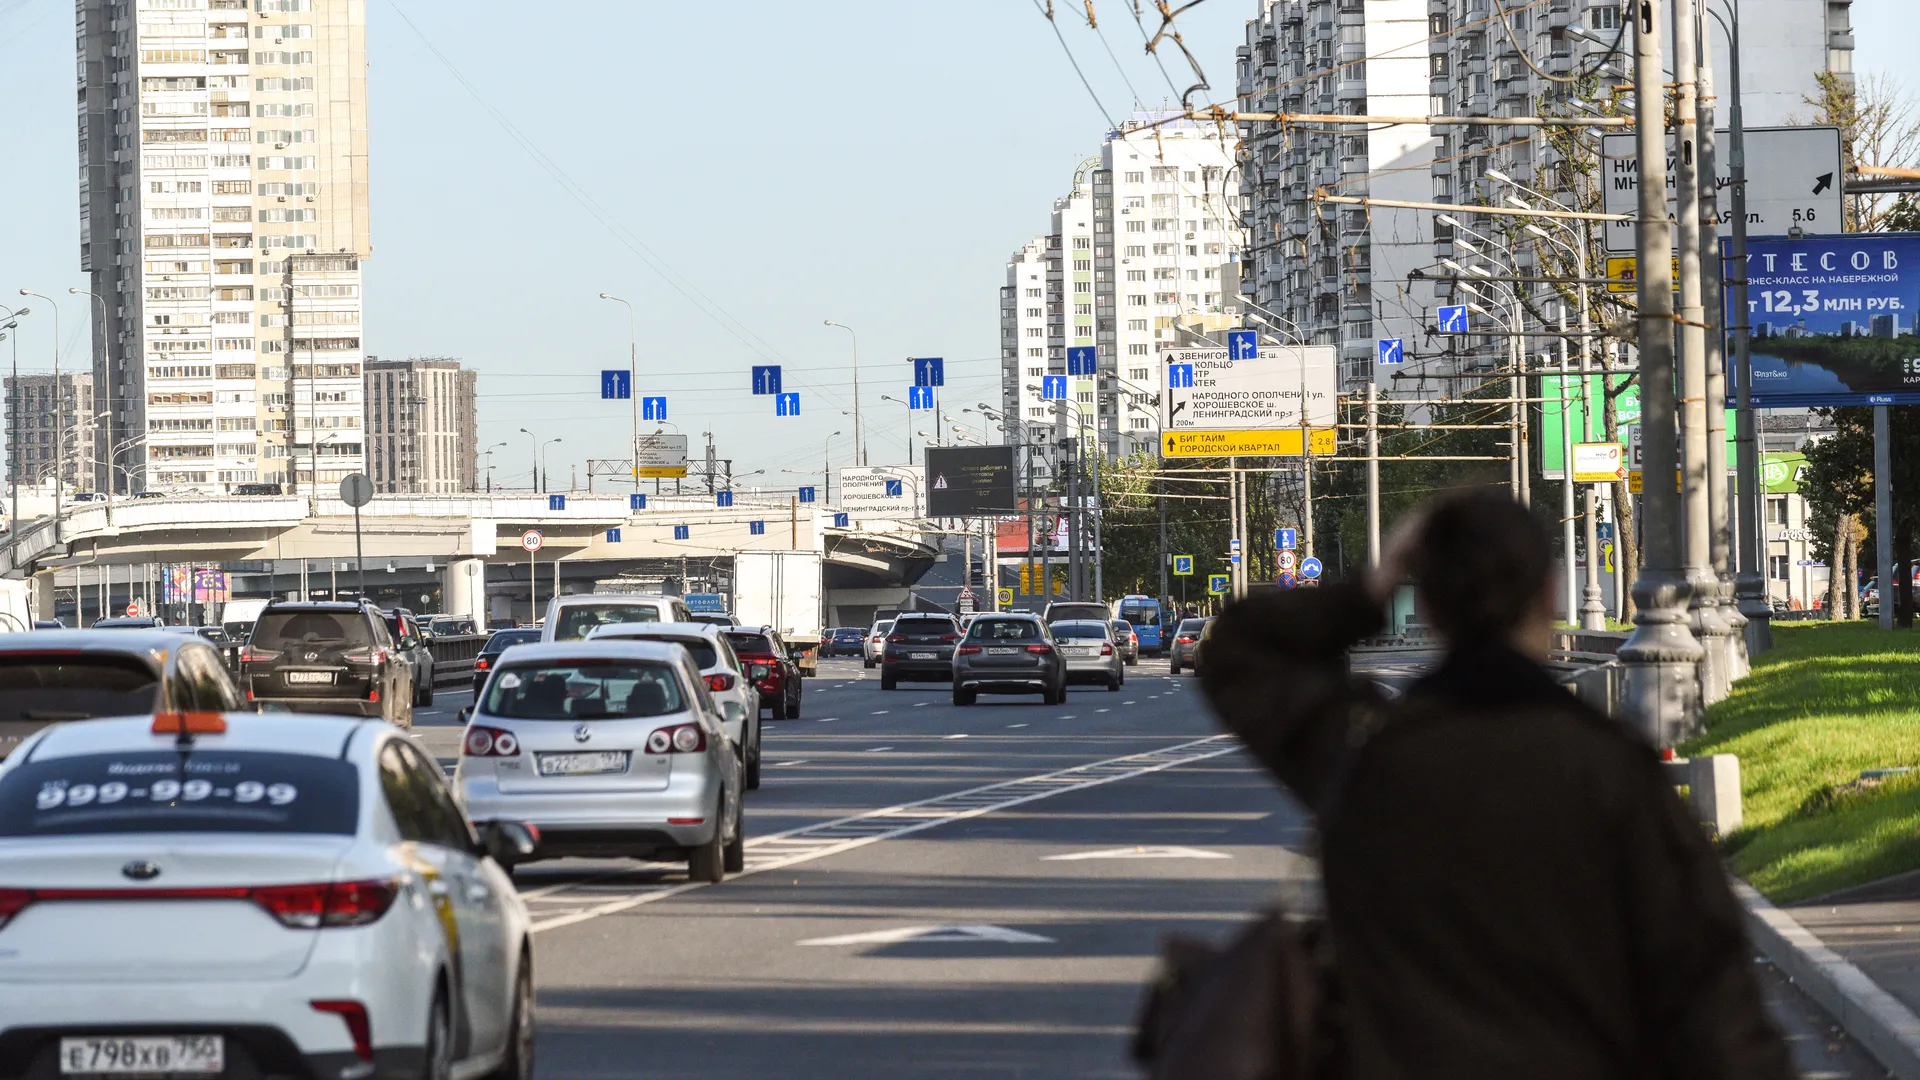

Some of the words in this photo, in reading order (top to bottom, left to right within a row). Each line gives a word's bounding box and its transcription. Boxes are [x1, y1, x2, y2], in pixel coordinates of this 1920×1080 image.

[1792, 208, 1816, 222] 5.6
[1747, 250, 1898, 273] ТЕСОВ
[1747, 276, 1810, 286] ЗНЕС-КЛАСС
[1812, 276, 1826, 285] НА
[1828, 272, 1899, 284] НАБЕРЕЖНОЙ
[1760, 289, 1820, 317] 12,3
[1824, 298, 1862, 312] МЛН
[1866, 297, 1906, 311] РУБ.
[1268, 352, 1279, 360] ш.
[1194, 361, 1234, 370] КОЛЬЦО
[1192, 391, 1249, 401] НАРОДНОГО
[1312, 391, 1326, 400] ул.
[1192, 401, 1264, 409] ХОРОШЕВСКОЕ
[1192, 409, 1272, 419] ЛЕНИНГРАДСКИЙ
[1274, 411, 1294, 420] пр-т
[1175, 419, 1195, 427] 200м
[1179, 435, 1198, 443] БИГ
[1200, 434, 1226, 443] ТАЙМ
[1179, 443, 1236, 454] ГОРОДСКОЙ
[1238, 443, 1280, 452] КВАРТАЛ
[1318, 438, 1331, 446] 2.8
[842, 474, 884, 482] НАРОДНОГО
[842, 504, 900, 513] ЛЕНИНГРАДСКИЙ
[526, 536, 539, 545] 80
[1280, 556, 1292, 565] 80
[36, 779, 297, 809] 999-99-99
